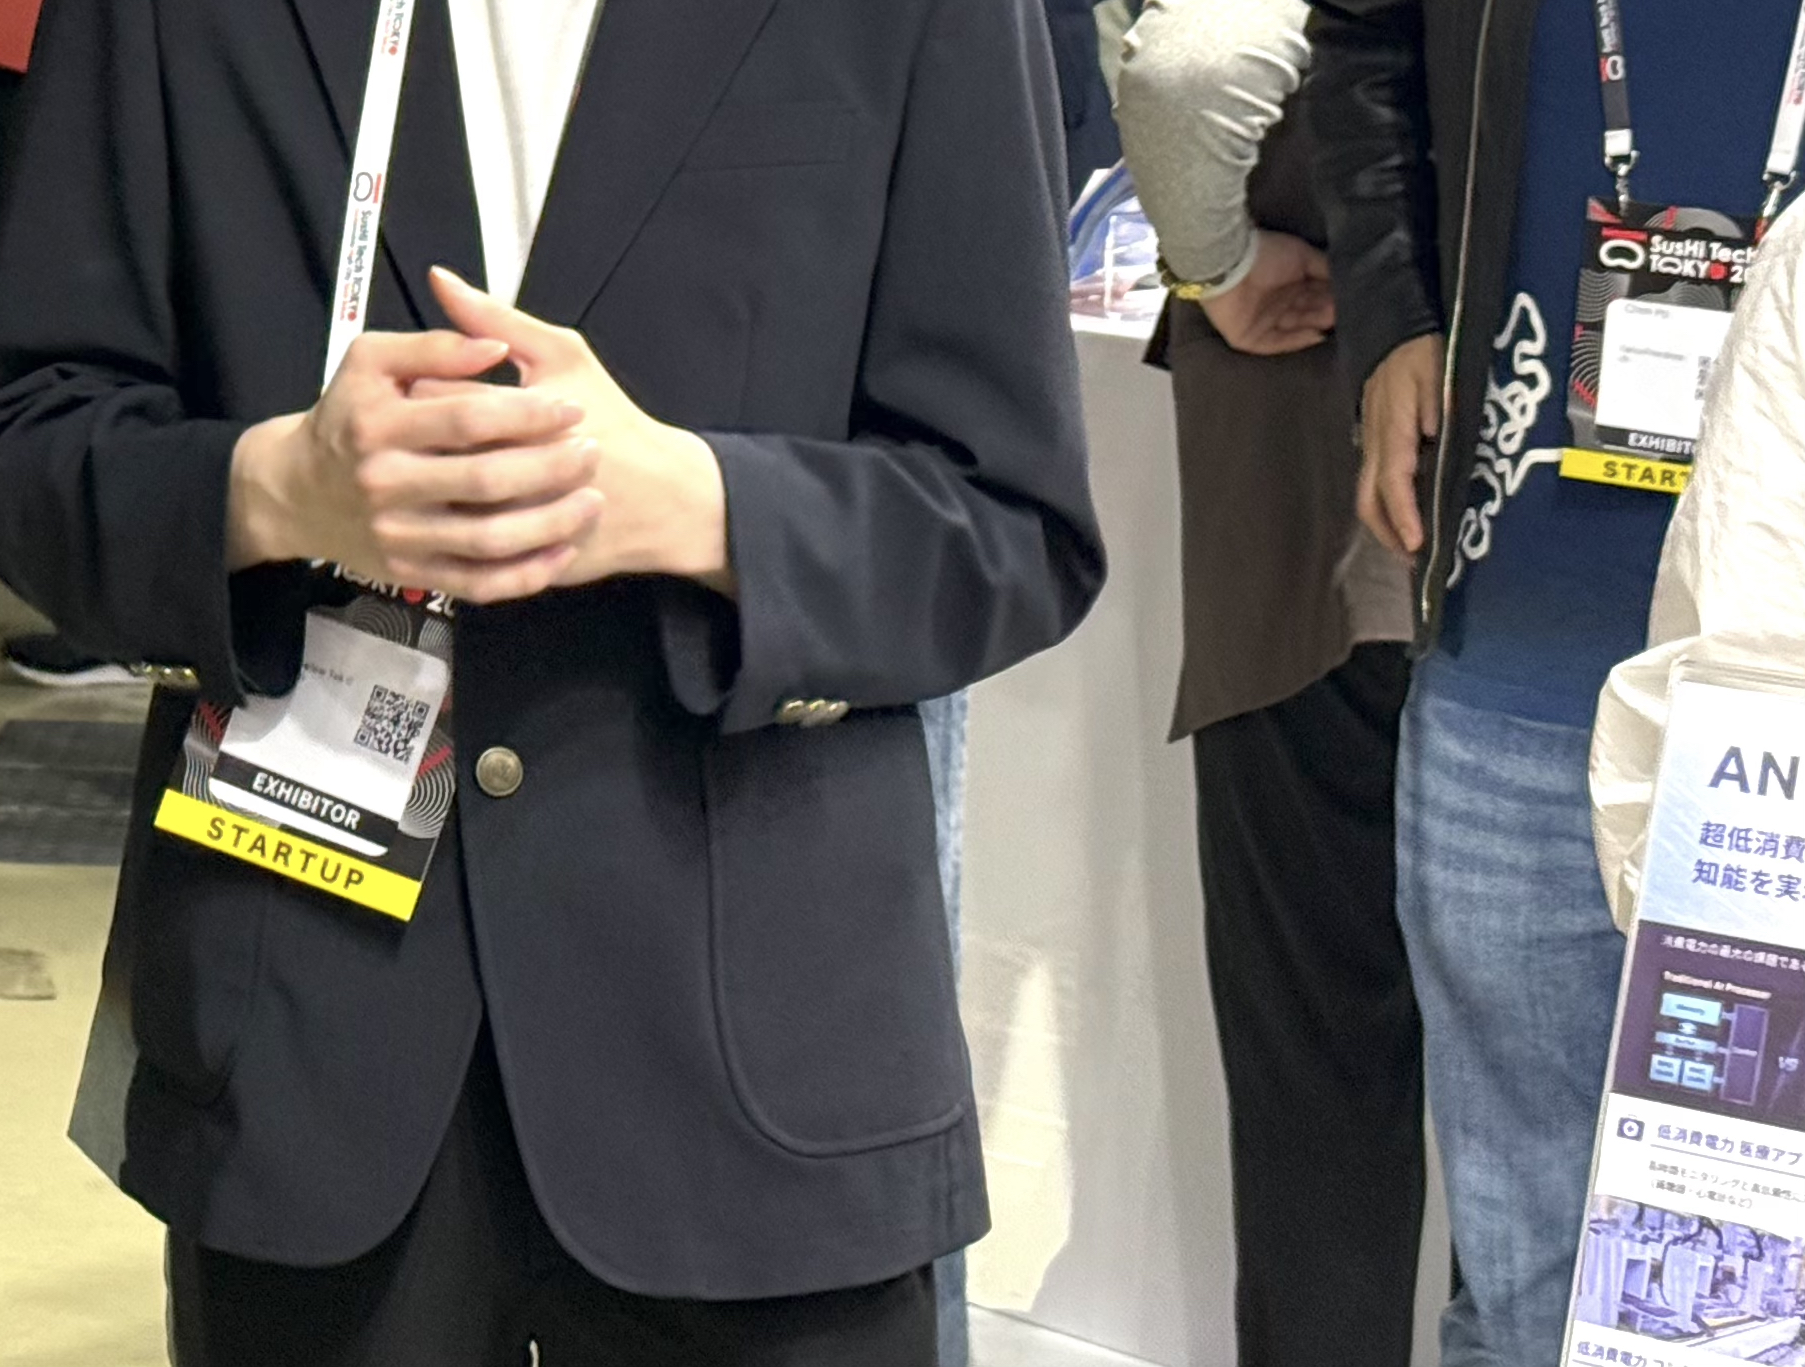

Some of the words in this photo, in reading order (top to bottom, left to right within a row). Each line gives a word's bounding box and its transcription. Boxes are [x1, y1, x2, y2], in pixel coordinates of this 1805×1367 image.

[1628, 432, 1696, 455] EXHIBIT
[251, 771, 362, 831] EXHIBITOR
[1708, 745, 1801, 801] AN
[206, 816, 365, 891] STARTUP
[1691, 858, 1805, 902] 知能を実
